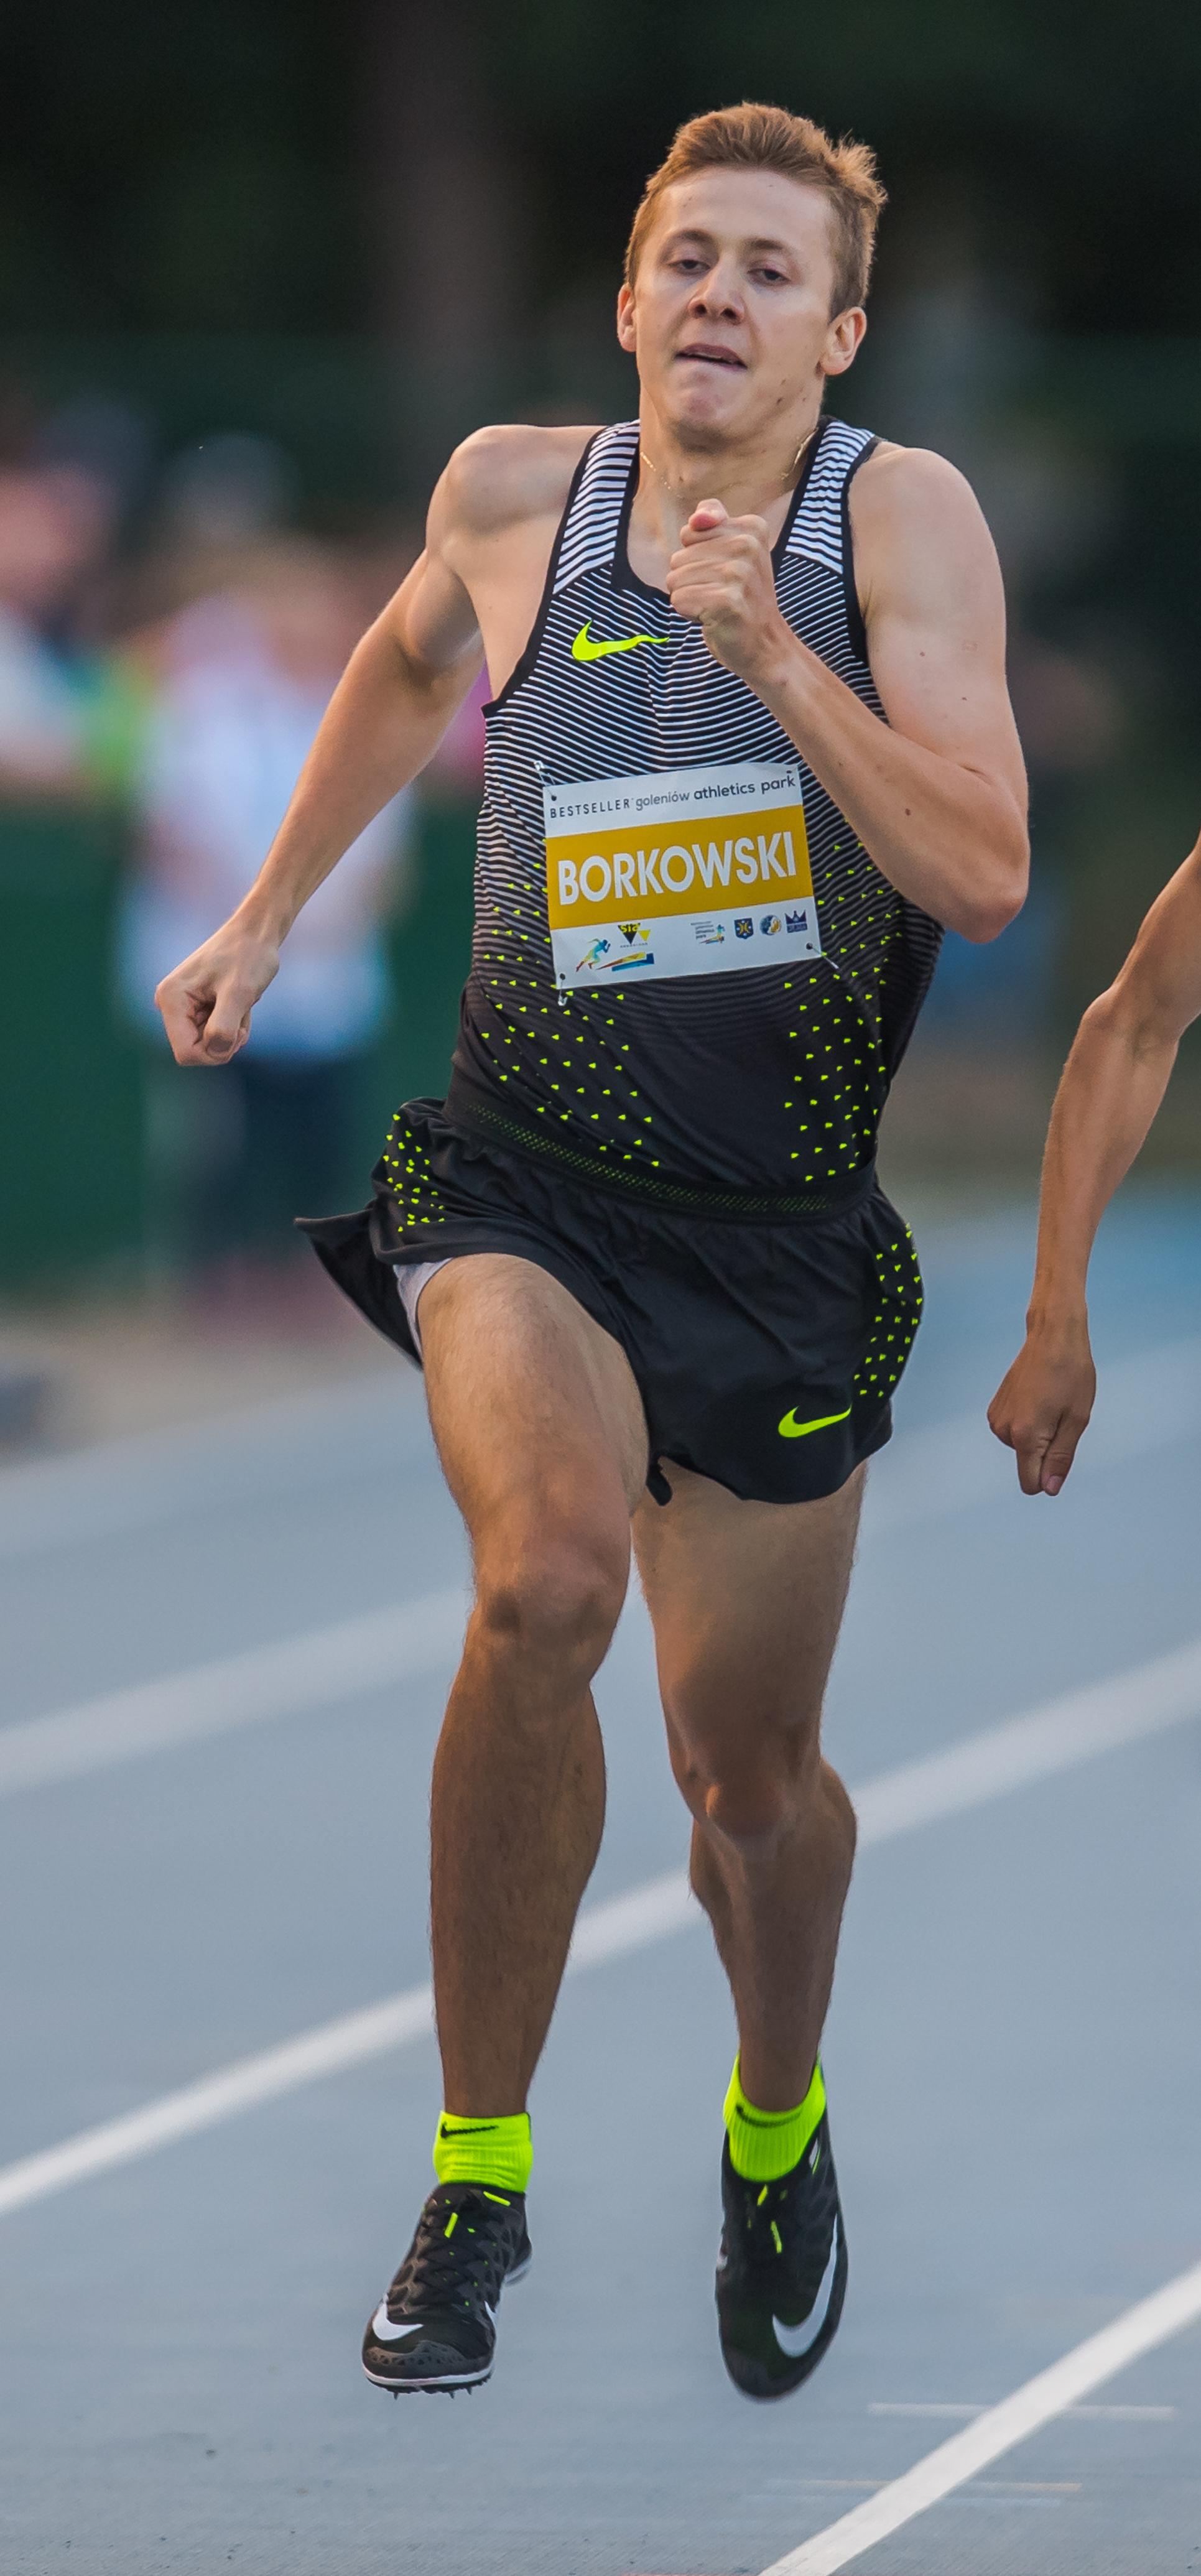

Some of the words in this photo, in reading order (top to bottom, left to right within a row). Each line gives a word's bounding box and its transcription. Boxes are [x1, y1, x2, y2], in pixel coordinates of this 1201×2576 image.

[549, 798, 629, 818] BESTSELLER
[636, 791, 690, 811] goleniów
[693, 783, 755, 800] athletics
[761, 775, 795, 794] park
[557, 831, 797, 906] BORKOWSKI
